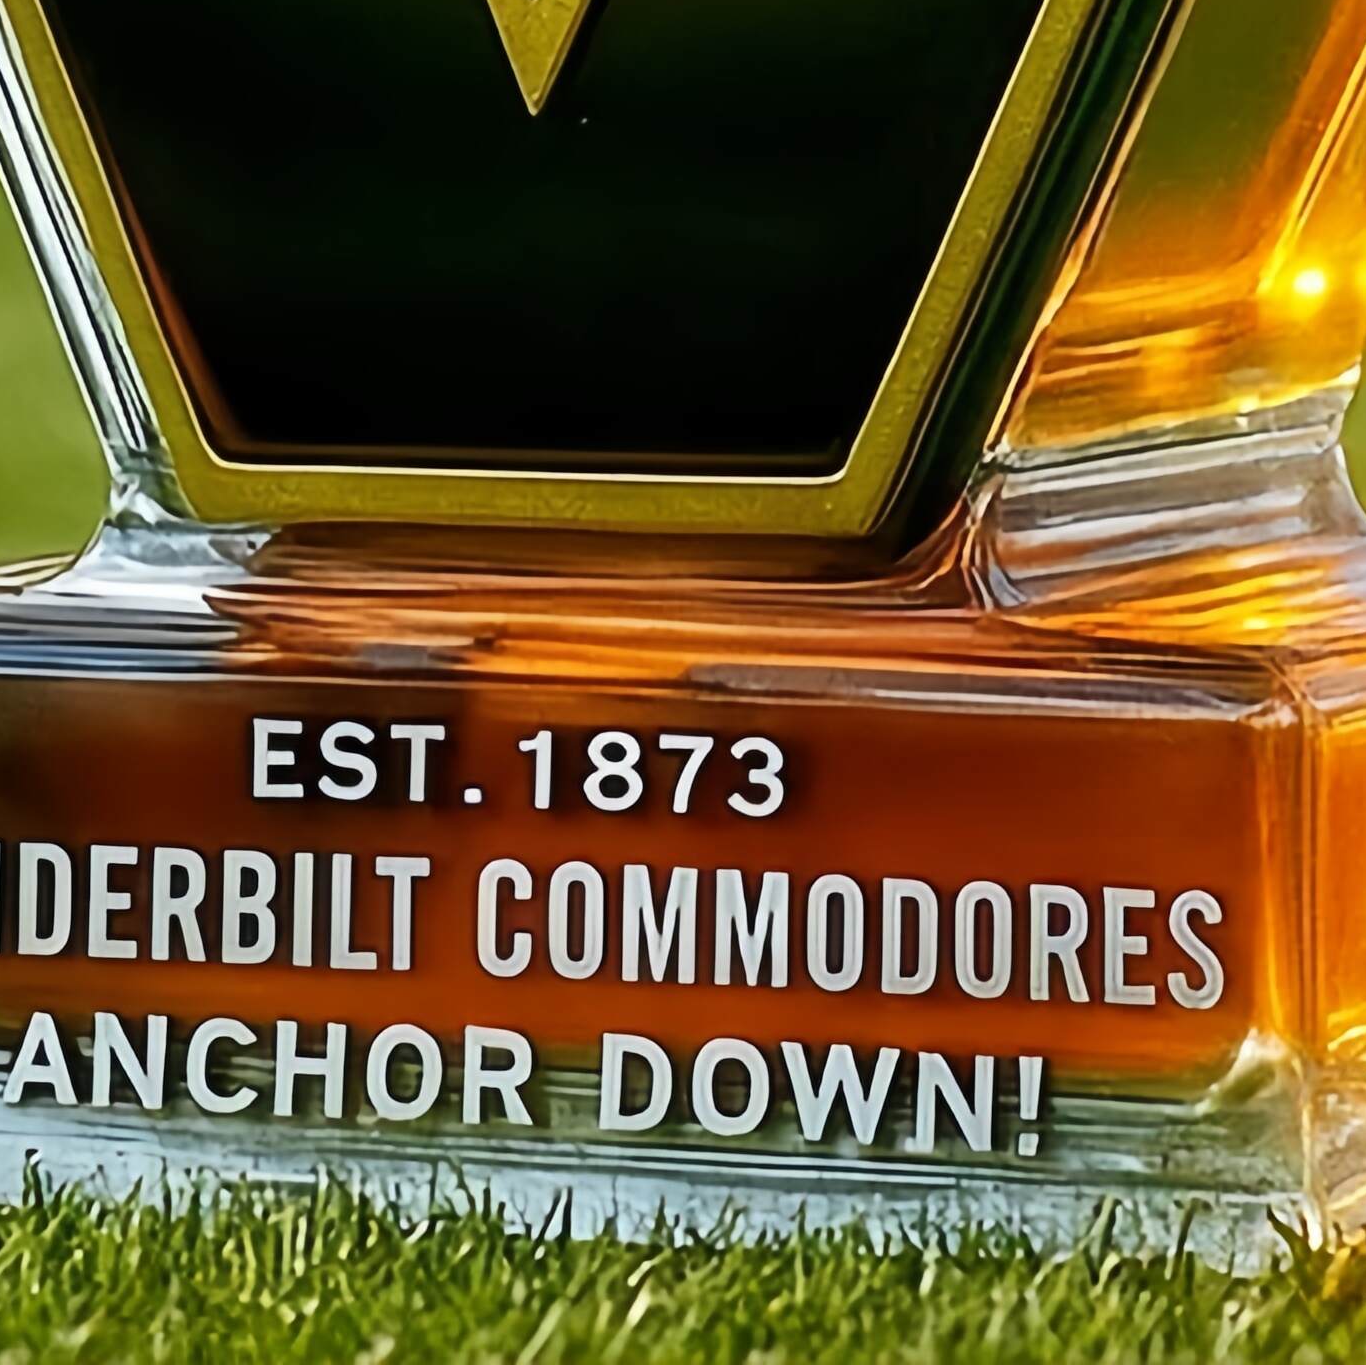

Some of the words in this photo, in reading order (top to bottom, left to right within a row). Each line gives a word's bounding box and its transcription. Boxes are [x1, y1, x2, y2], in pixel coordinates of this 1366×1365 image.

[250, 718, 484, 805] EST.
[518, 729, 787, 819] 1873
[475, 858, 1226, 1011] COMMODORES
[3, 1011, 534, 1126] ANCHOR
[598, 1032, 1045, 1158] DOWN!
